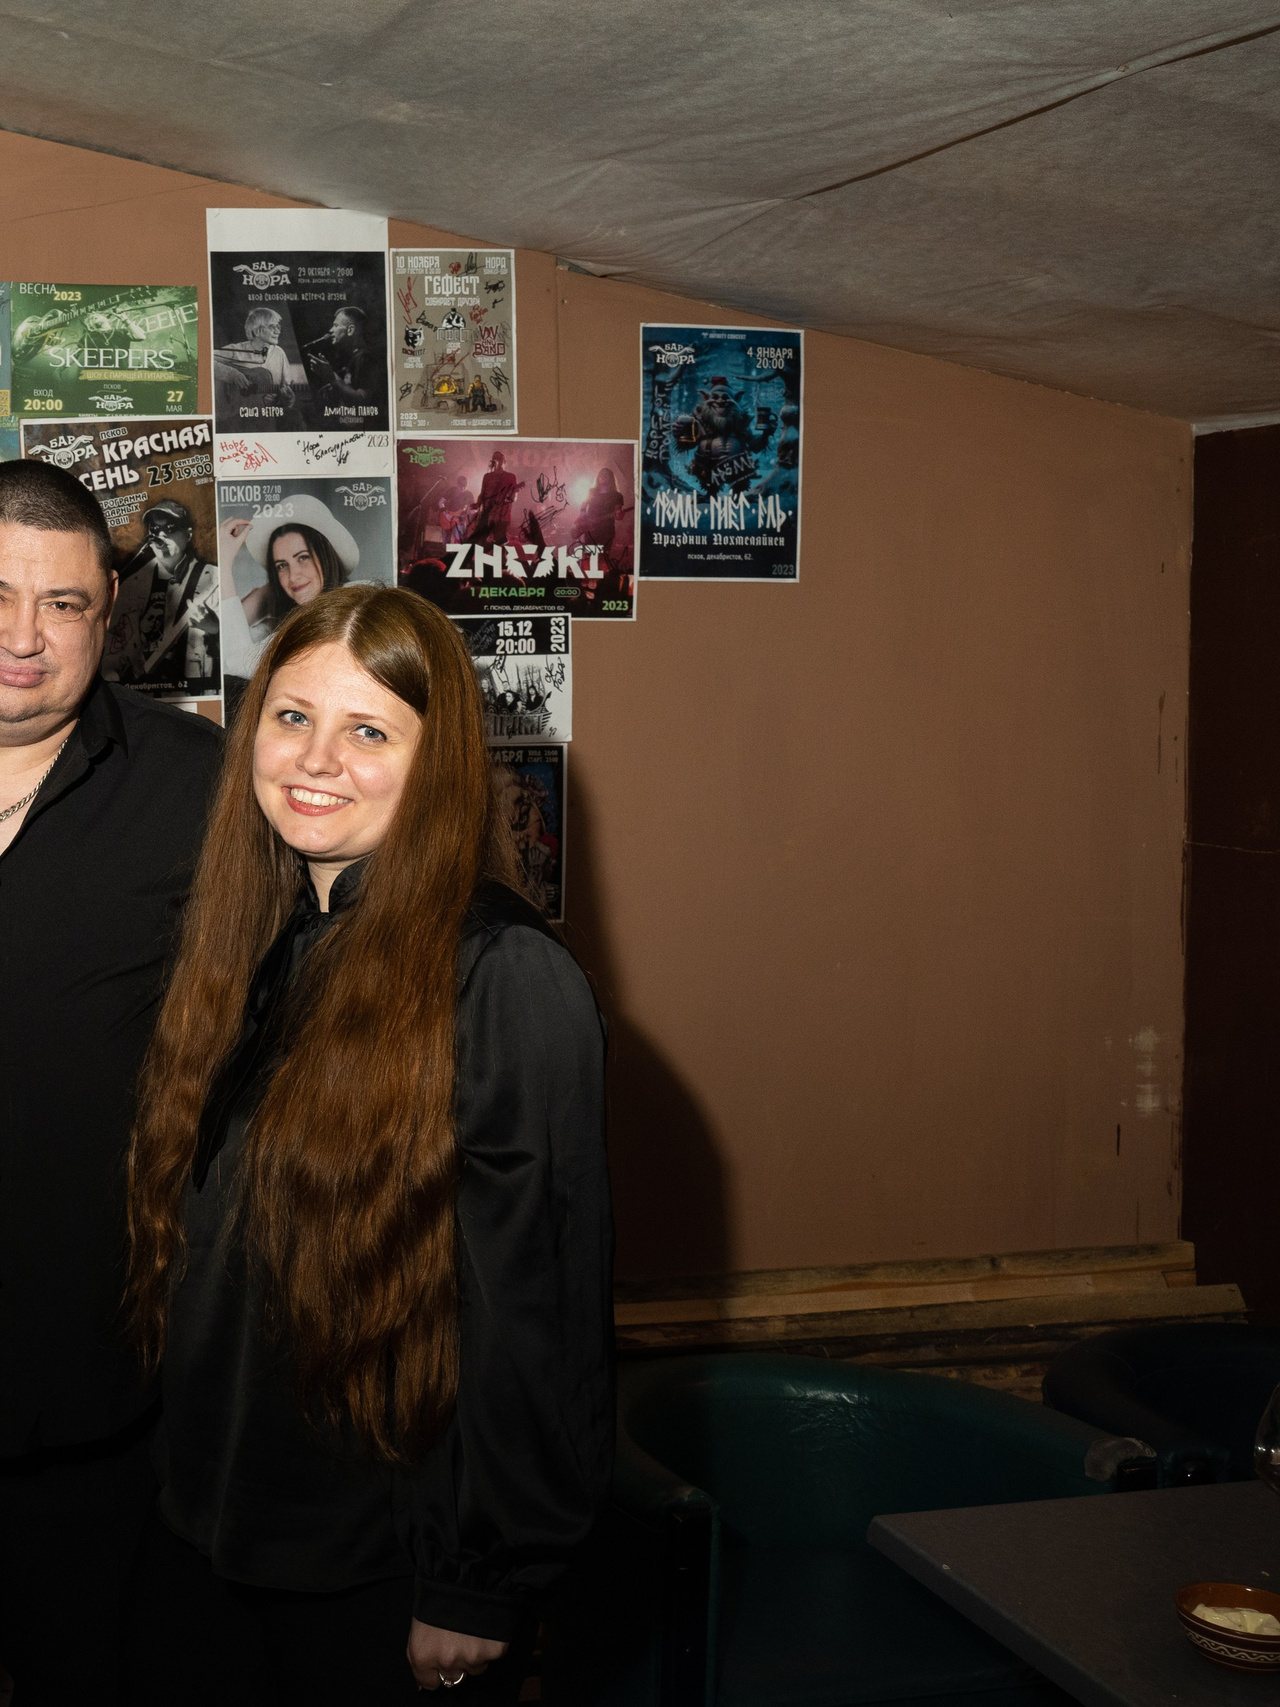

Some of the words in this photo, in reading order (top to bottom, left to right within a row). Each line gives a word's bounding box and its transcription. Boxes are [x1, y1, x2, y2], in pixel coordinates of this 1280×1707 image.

[252, 261, 275, 270] БАР
[396, 256, 405, 268] 10
[407, 256, 440, 269] НОЯБРЯ
[485, 257, 507, 269] НОРА
[297, 267, 305, 277] 29
[336, 267, 354, 277] 20:00
[20, 283, 57, 294] ВЕСНА
[424, 274, 480, 297] ГЕФЕСТ
[54, 291, 82, 301] 2023
[664, 343, 684, 351] БАР
[747, 346, 753, 358] 4
[756, 347, 794, 359] ЯНВАРЯ
[49, 348, 175, 369] SKEEPERS
[756, 357, 785, 369] 20:00
[86, 371, 103, 379] ШОУ
[109, 371, 143, 381] ПАРЯЩЕЙ
[144, 371, 175, 380] ГИТАРОЙ
[33, 389, 54, 397] ВХОД
[167, 391, 184, 402] 27
[24, 399, 63, 410] 20:00
[99, 427, 127, 441] ПСКОВ
[49, 435, 76, 449] БАР
[102, 423, 211, 464] КРАСНАЯ
[367, 434, 389, 447] 2023
[173, 454, 210, 467] сентября
[147, 464, 174, 487] 23
[176, 462, 212, 480] 19:00
[78, 464, 140, 492] СЕНЬ
[262, 485, 282, 494] 27/10
[352, 482, 373, 491] БАР
[220, 485, 261, 502] ПСКОВ
[343, 495, 387, 511] НОРА
[252, 503, 295, 519] 2023
[652, 532, 708, 549] Праздник
[712, 532, 785, 547] Похмеляйнен
[706, 552, 743, 561] декабристов,
[772, 564, 794, 575] 2023
[470, 587, 476, 598] 1
[479, 587, 546, 598] ДЕКАБРЯ
[554, 588, 578, 596] 20:00
[602, 600, 629, 611] 2023
[497, 620, 532, 636] 15.12
[550, 617, 565, 652] 2023
[495, 638, 536, 654] 20:00
[177, 680, 188, 688] 62
